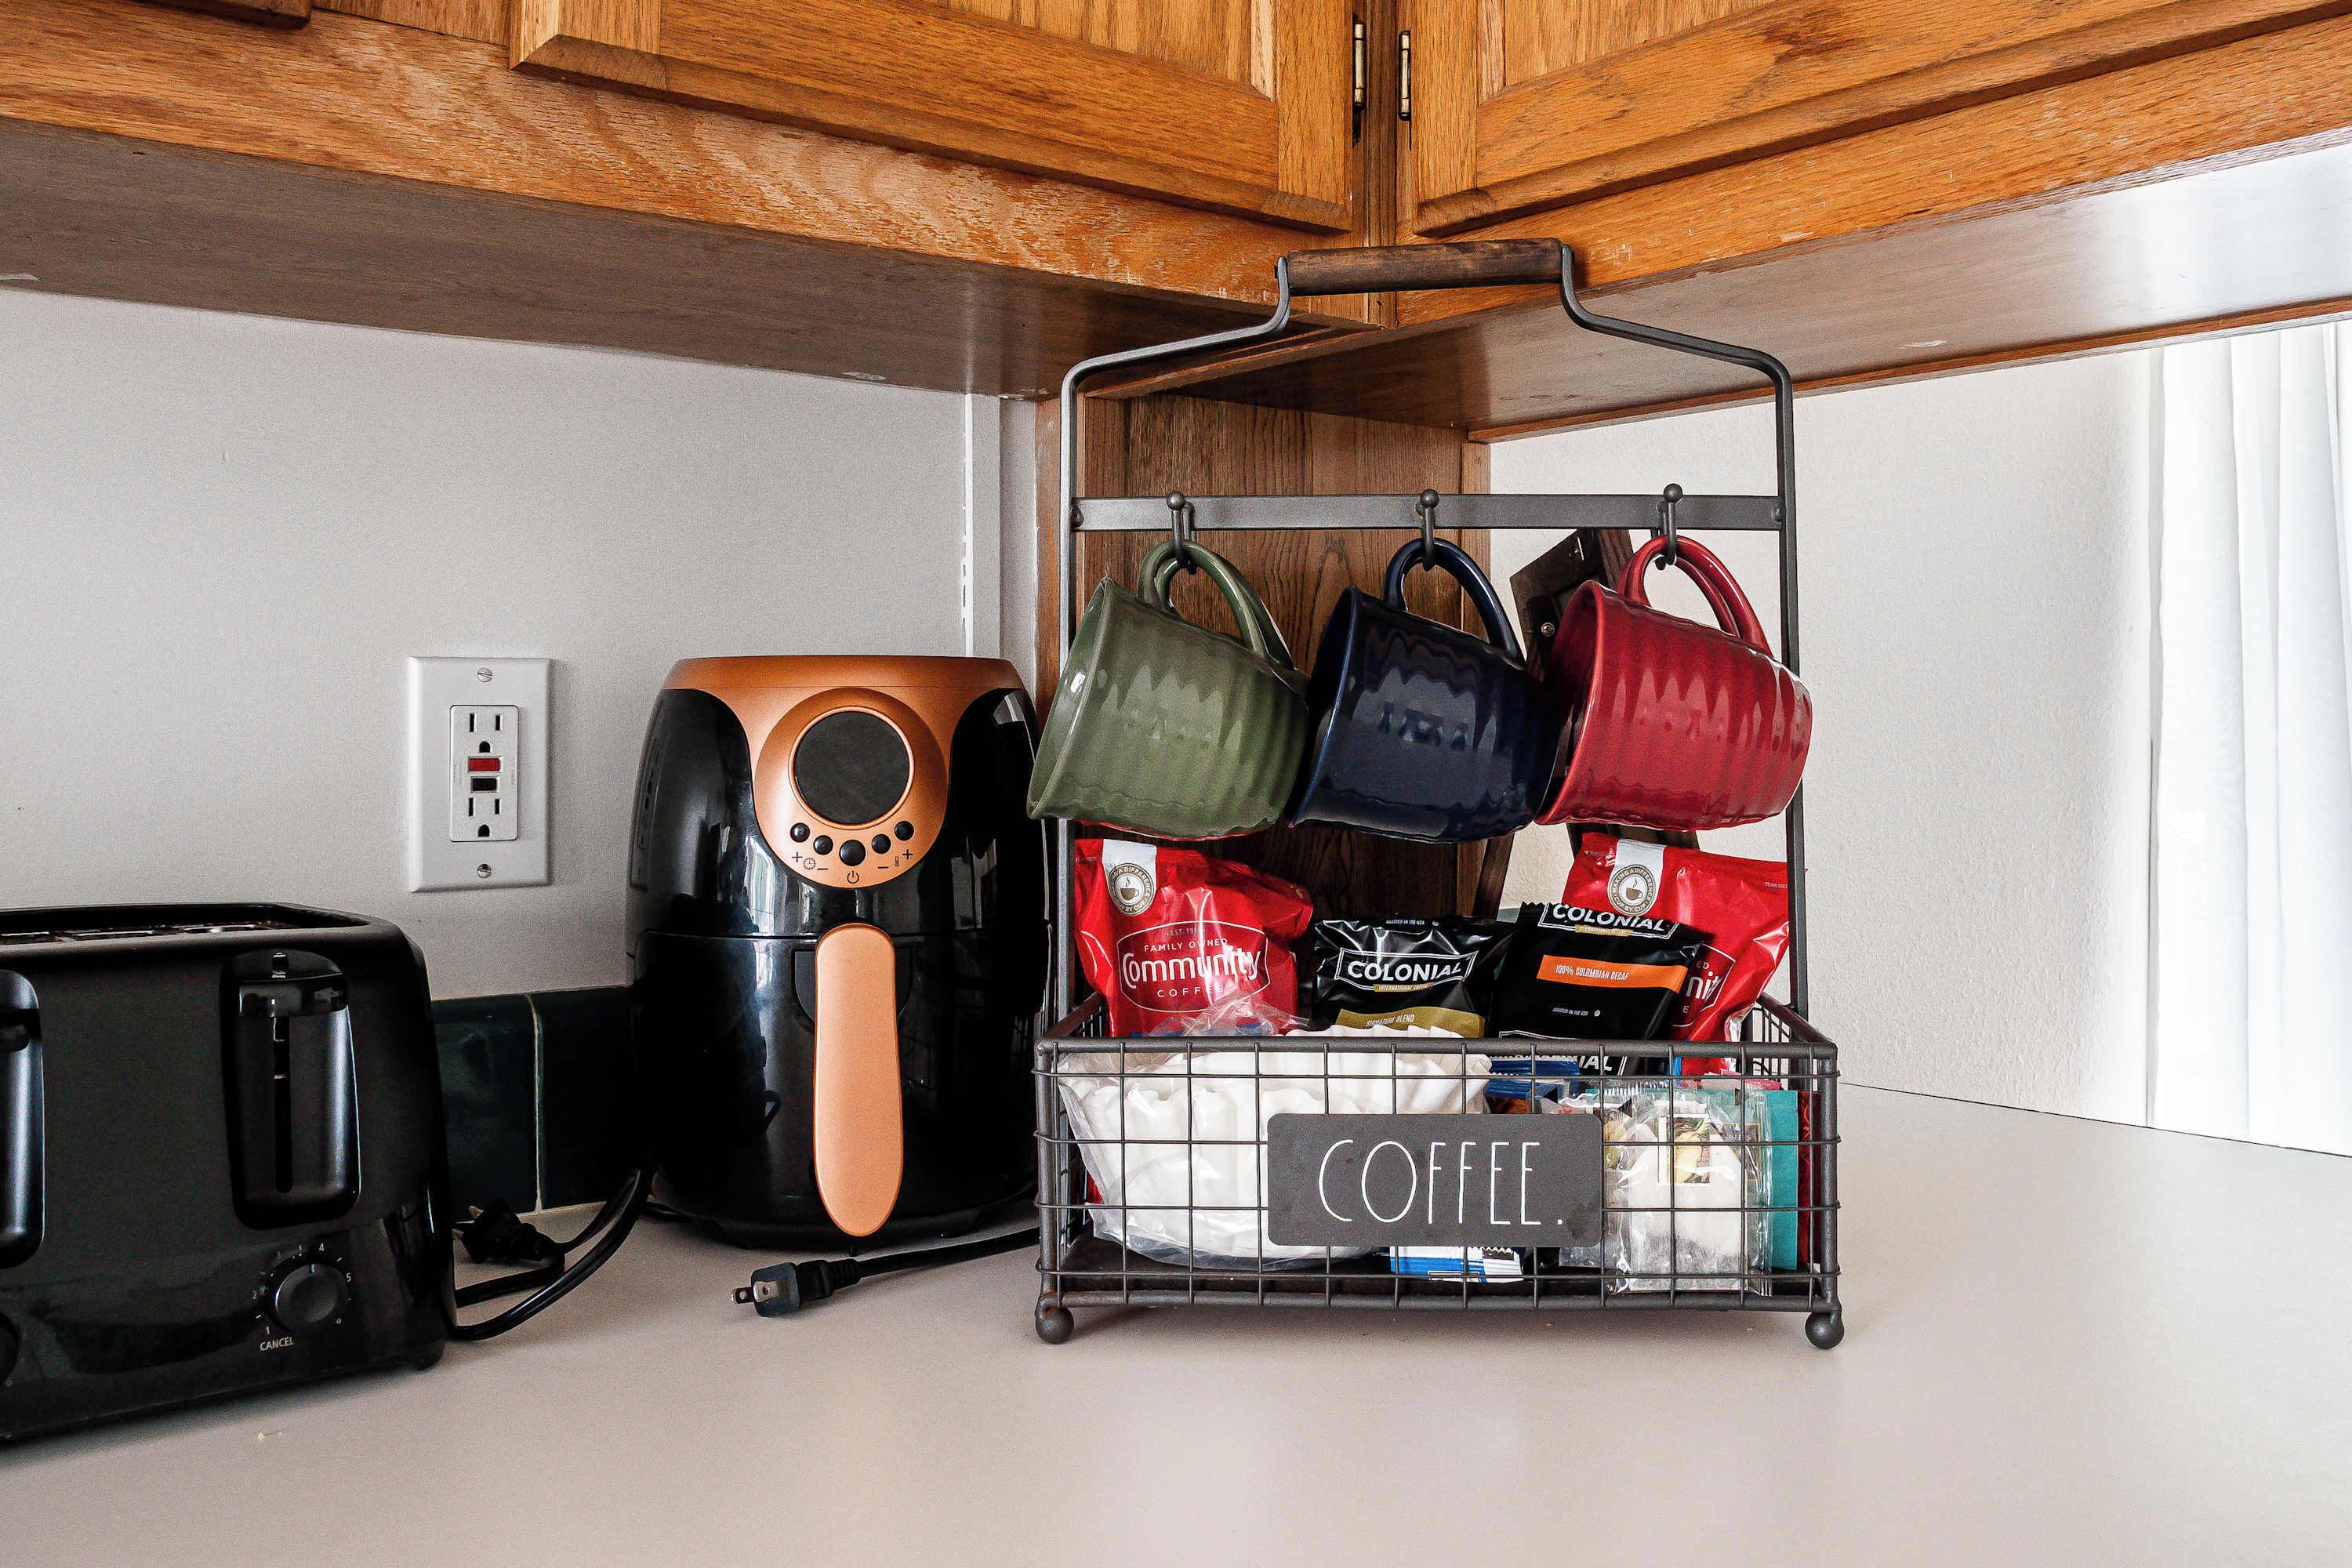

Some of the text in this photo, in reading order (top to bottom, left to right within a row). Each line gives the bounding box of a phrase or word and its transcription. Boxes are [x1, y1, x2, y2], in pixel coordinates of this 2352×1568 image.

[1612, 871, 1629, 893] MAKING
[1635, 868, 1653, 901] DIFFERENCE
[1552, 903, 1664, 931] COLONIAL
[1144, 942, 1183, 952] FAMILY
[1123, 946, 1261, 989] Community
[1347, 960, 1461, 982] COLONIAL
[1555, 964, 1630, 981] 100% COLOMBIAN DECAF
[1396, 1014, 1415, 1023] BLEND
[318, 1243, 325, 1252] 4
[346, 1273, 351, 1282] 5
[260, 1336, 295, 1351] CANCEL
